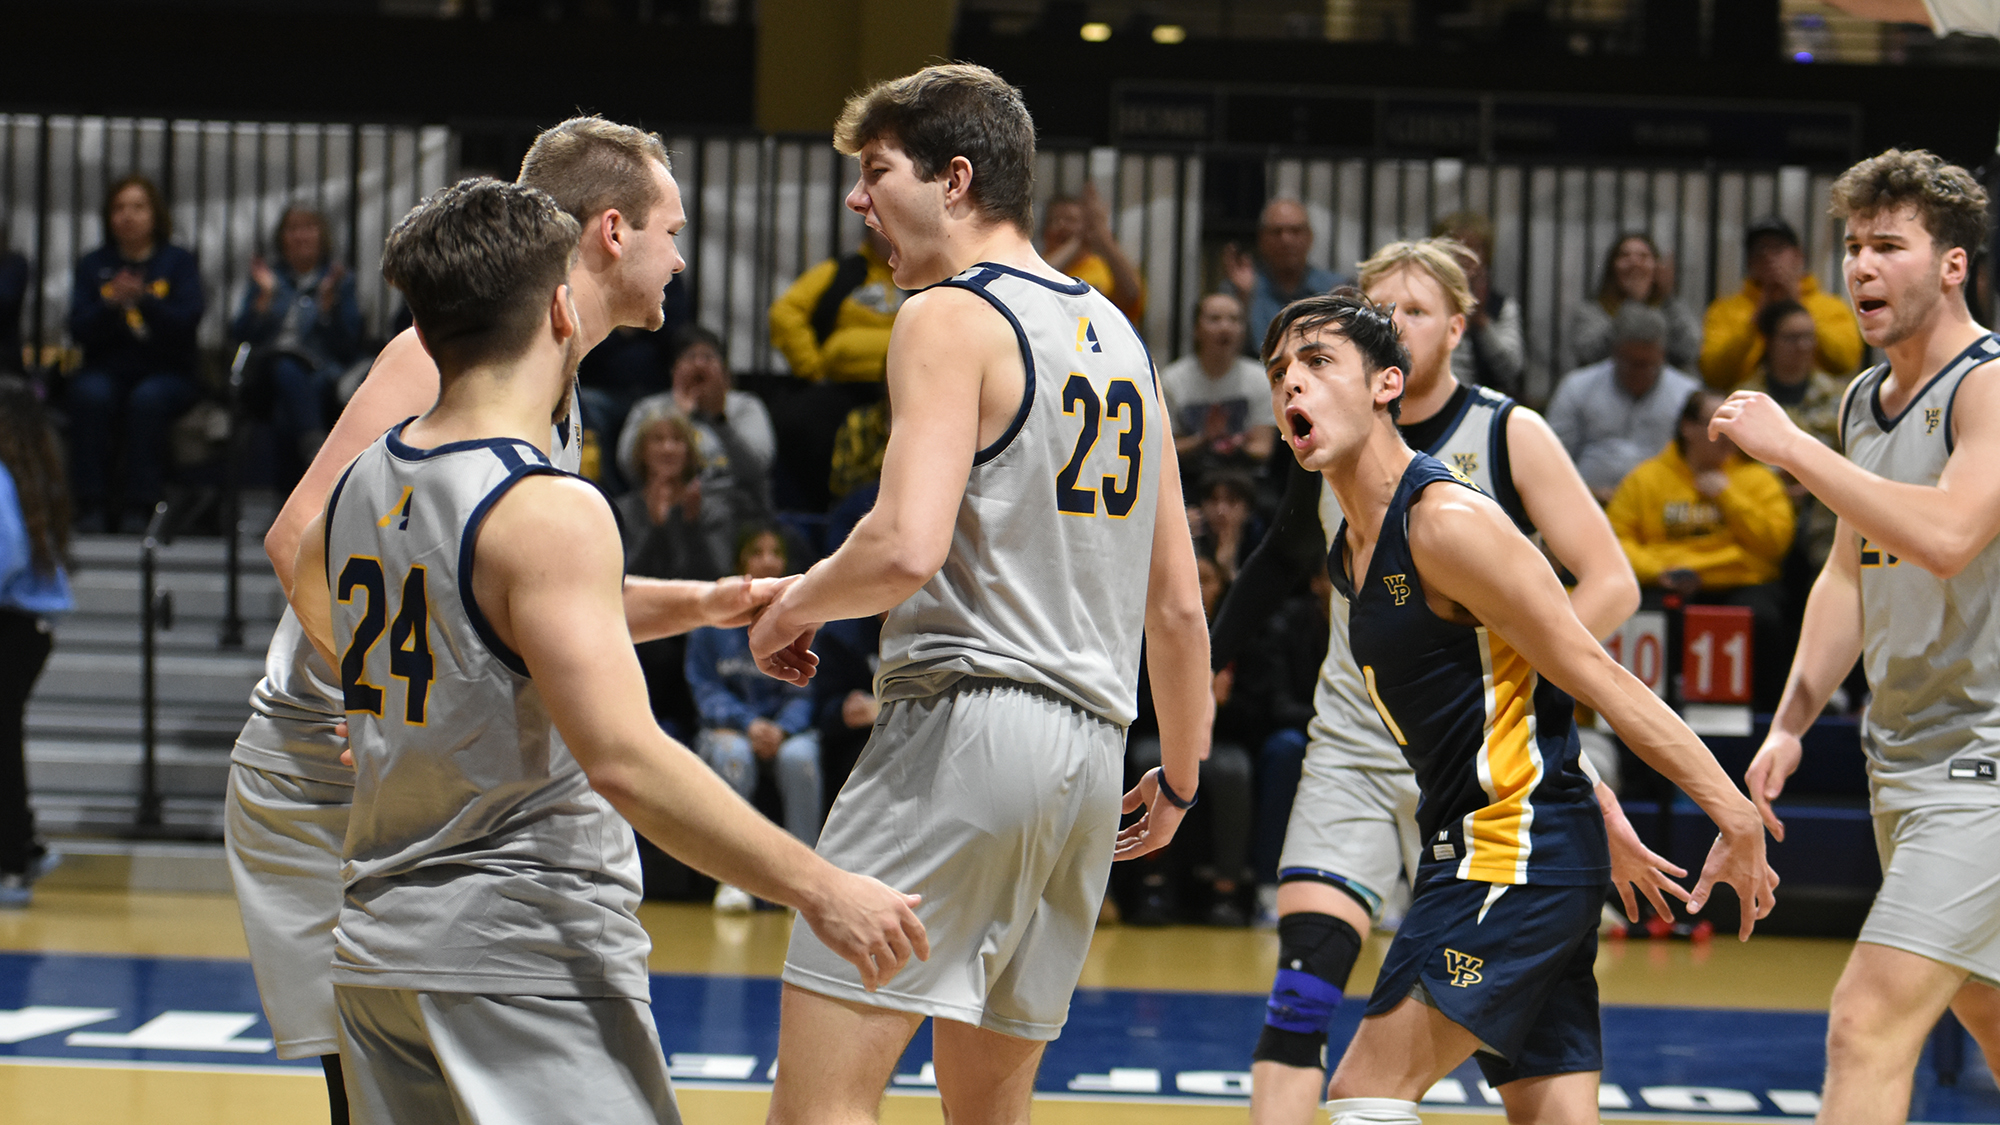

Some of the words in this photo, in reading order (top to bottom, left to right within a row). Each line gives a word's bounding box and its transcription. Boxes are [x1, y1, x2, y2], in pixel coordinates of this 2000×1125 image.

[1055, 371, 1146, 520] 23
[337, 553, 436, 727] 24
[1690, 631, 1748, 696] 11
[1979, 764, 1993, 775] XL
[1438, 830, 1449, 841] M
